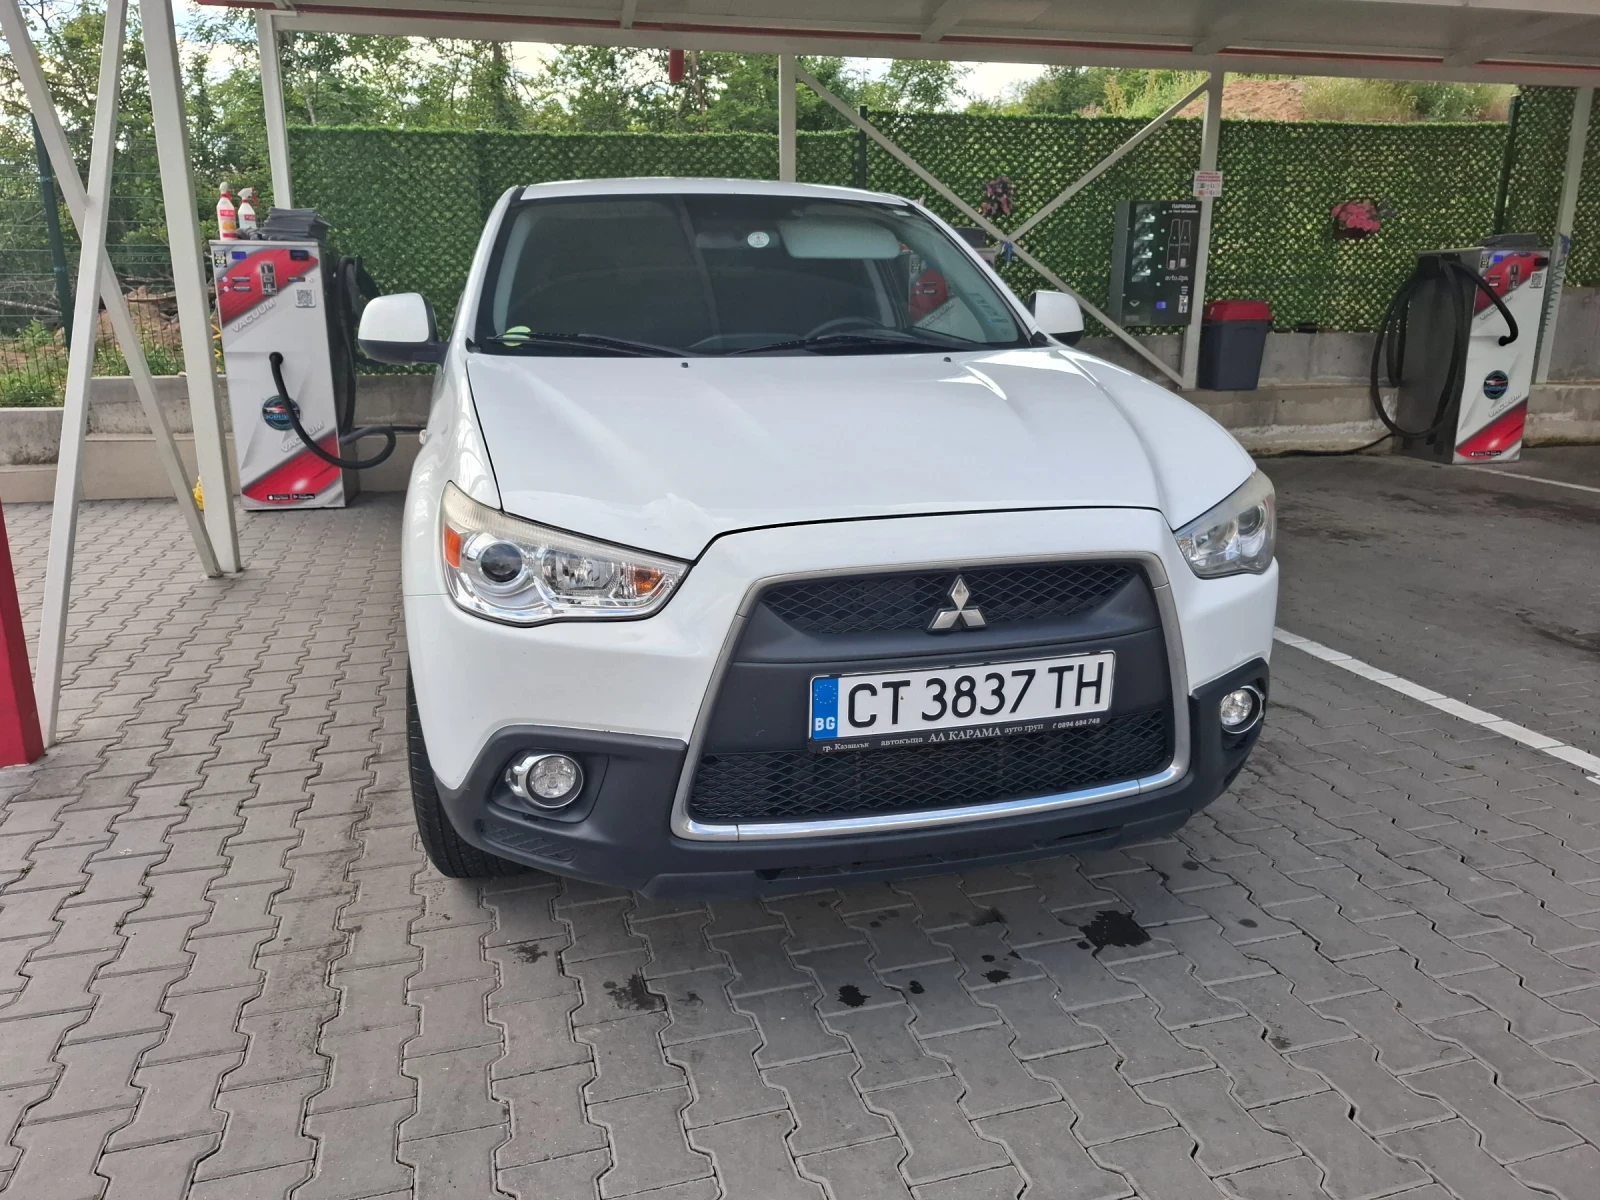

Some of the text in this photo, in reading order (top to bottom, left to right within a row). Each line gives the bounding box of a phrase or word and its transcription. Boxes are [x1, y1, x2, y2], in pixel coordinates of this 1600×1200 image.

[232, 298, 276, 332] VACUUM
[921, 300, 955, 328] ACUUM
[1480, 293, 1513, 320] VACM
[1488, 391, 1522, 418] VACUUM
[281, 421, 325, 453] VACUM
[847, 661, 1105, 728] CT 3837 TH
[814, 716, 836, 731] BG
[880, 736, 923, 746] автокъща
[948, 726, 1001, 741] КАРАМА
[1004, 725, 1022, 734] ауто
[1024, 723, 1044, 733] груп
